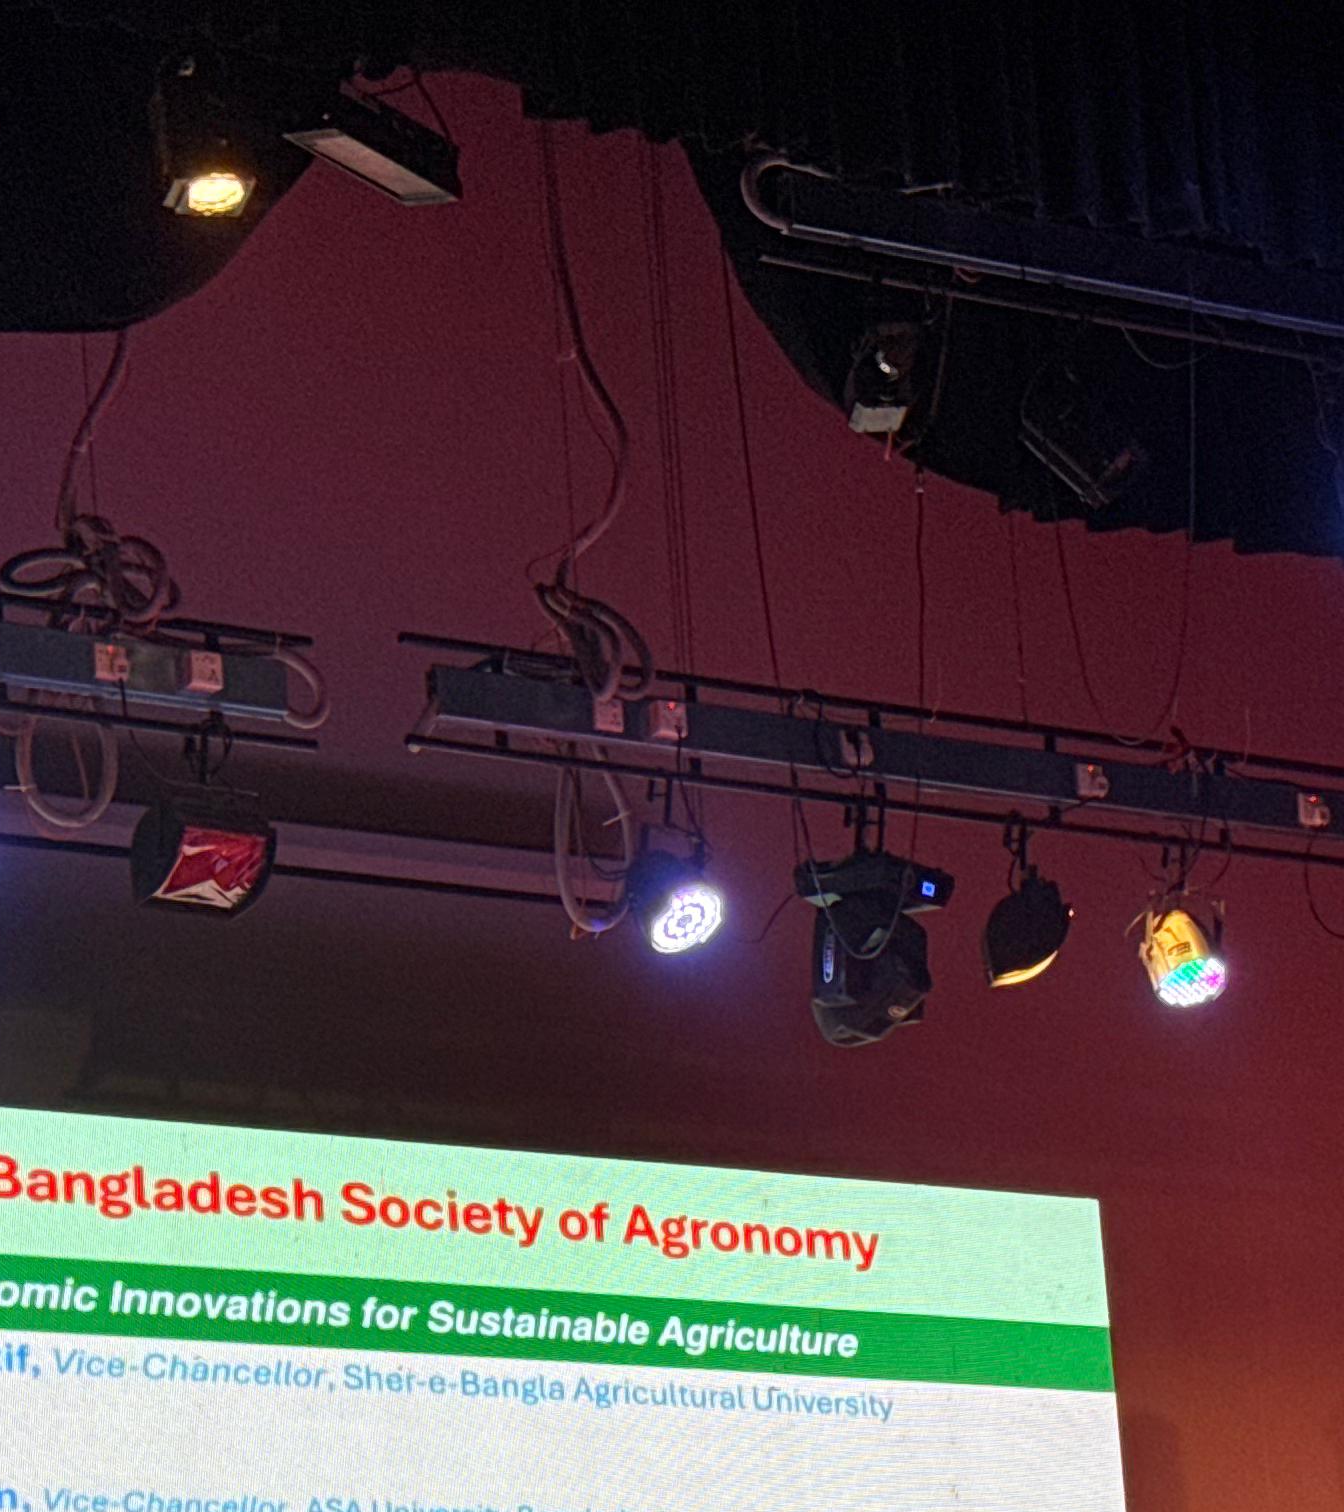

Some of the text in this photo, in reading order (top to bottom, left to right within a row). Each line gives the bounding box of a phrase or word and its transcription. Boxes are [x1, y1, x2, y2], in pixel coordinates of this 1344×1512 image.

[340, 1181, 543, 1248] Society
[558, 1202, 610, 1242] of
[623, 1204, 879, 1272] Agronomy
[108, 1279, 352, 1328] Innovations
[360, 1295, 419, 1331] for
[426, 1299, 652, 1347] Sustainable
[656, 1314, 860, 1360] Agriculture
[54, 1348, 337, 1394] Vice-Chancellor,
[342, 1362, 565, 1406] Sher-e-Bangla
[573, 1378, 746, 1412] Agricultural
[752, 1386, 893, 1422] University
